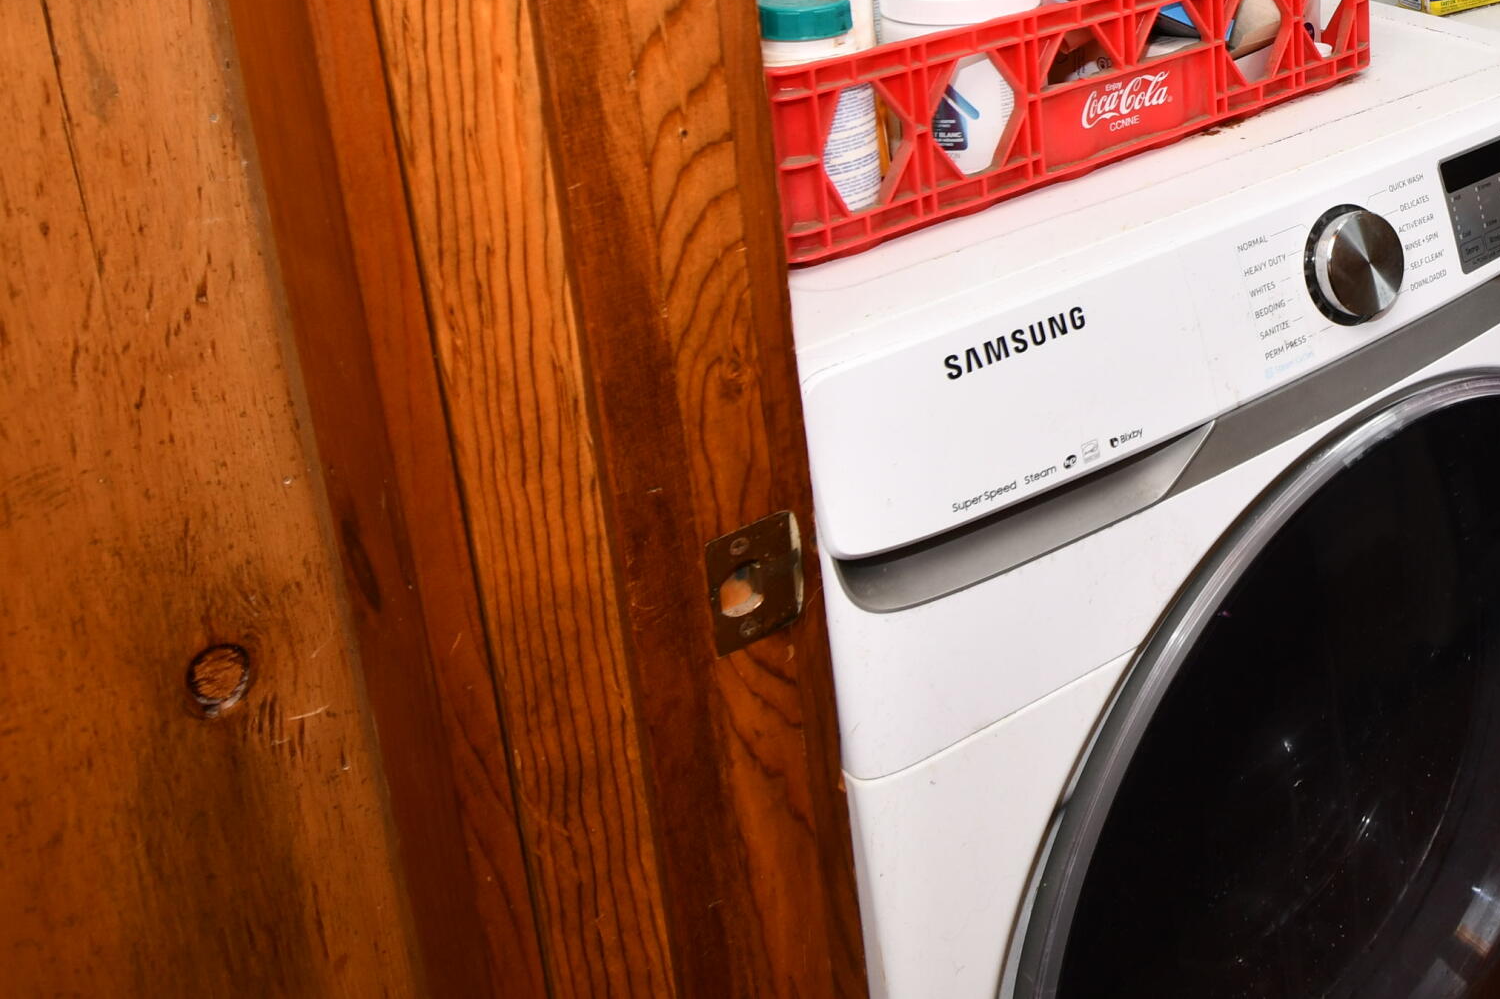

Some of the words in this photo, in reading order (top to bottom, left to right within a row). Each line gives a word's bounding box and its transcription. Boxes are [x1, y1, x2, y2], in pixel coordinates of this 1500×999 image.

[1105, 81, 1122, 92] Enjoy
[1081, 70, 1170, 129] Coca-Cola
[1388, 181, 1406, 193] QUICK
[1407, 173, 1424, 186] WASH
[1399, 195, 1430, 212] DELICATES
[1398, 214, 1434, 233] ACTIVEWEAR
[1237, 235, 1268, 253] NORMAL
[1244, 261, 1267, 277] HEAVY
[1268, 254, 1286, 268] DUTY
[1410, 258, 1423, 270] SELF
[1250, 282, 1276, 298] WHITES
[1410, 269, 1447, 291] DOWNLOADED
[1254, 299, 1286, 319] BEDDING
[1259, 321, 1290, 339] SANITIZE
[944, 306, 1086, 380] SAMSUNG
[1264, 346, 1285, 361] PERM
[1284, 335, 1307, 351] PRESS
[952, 494, 982, 513] Super
[983, 481, 1017, 501] Speed
[1024, 465, 1057, 485] Steam
[1120, 427, 1144, 444] Bixby
